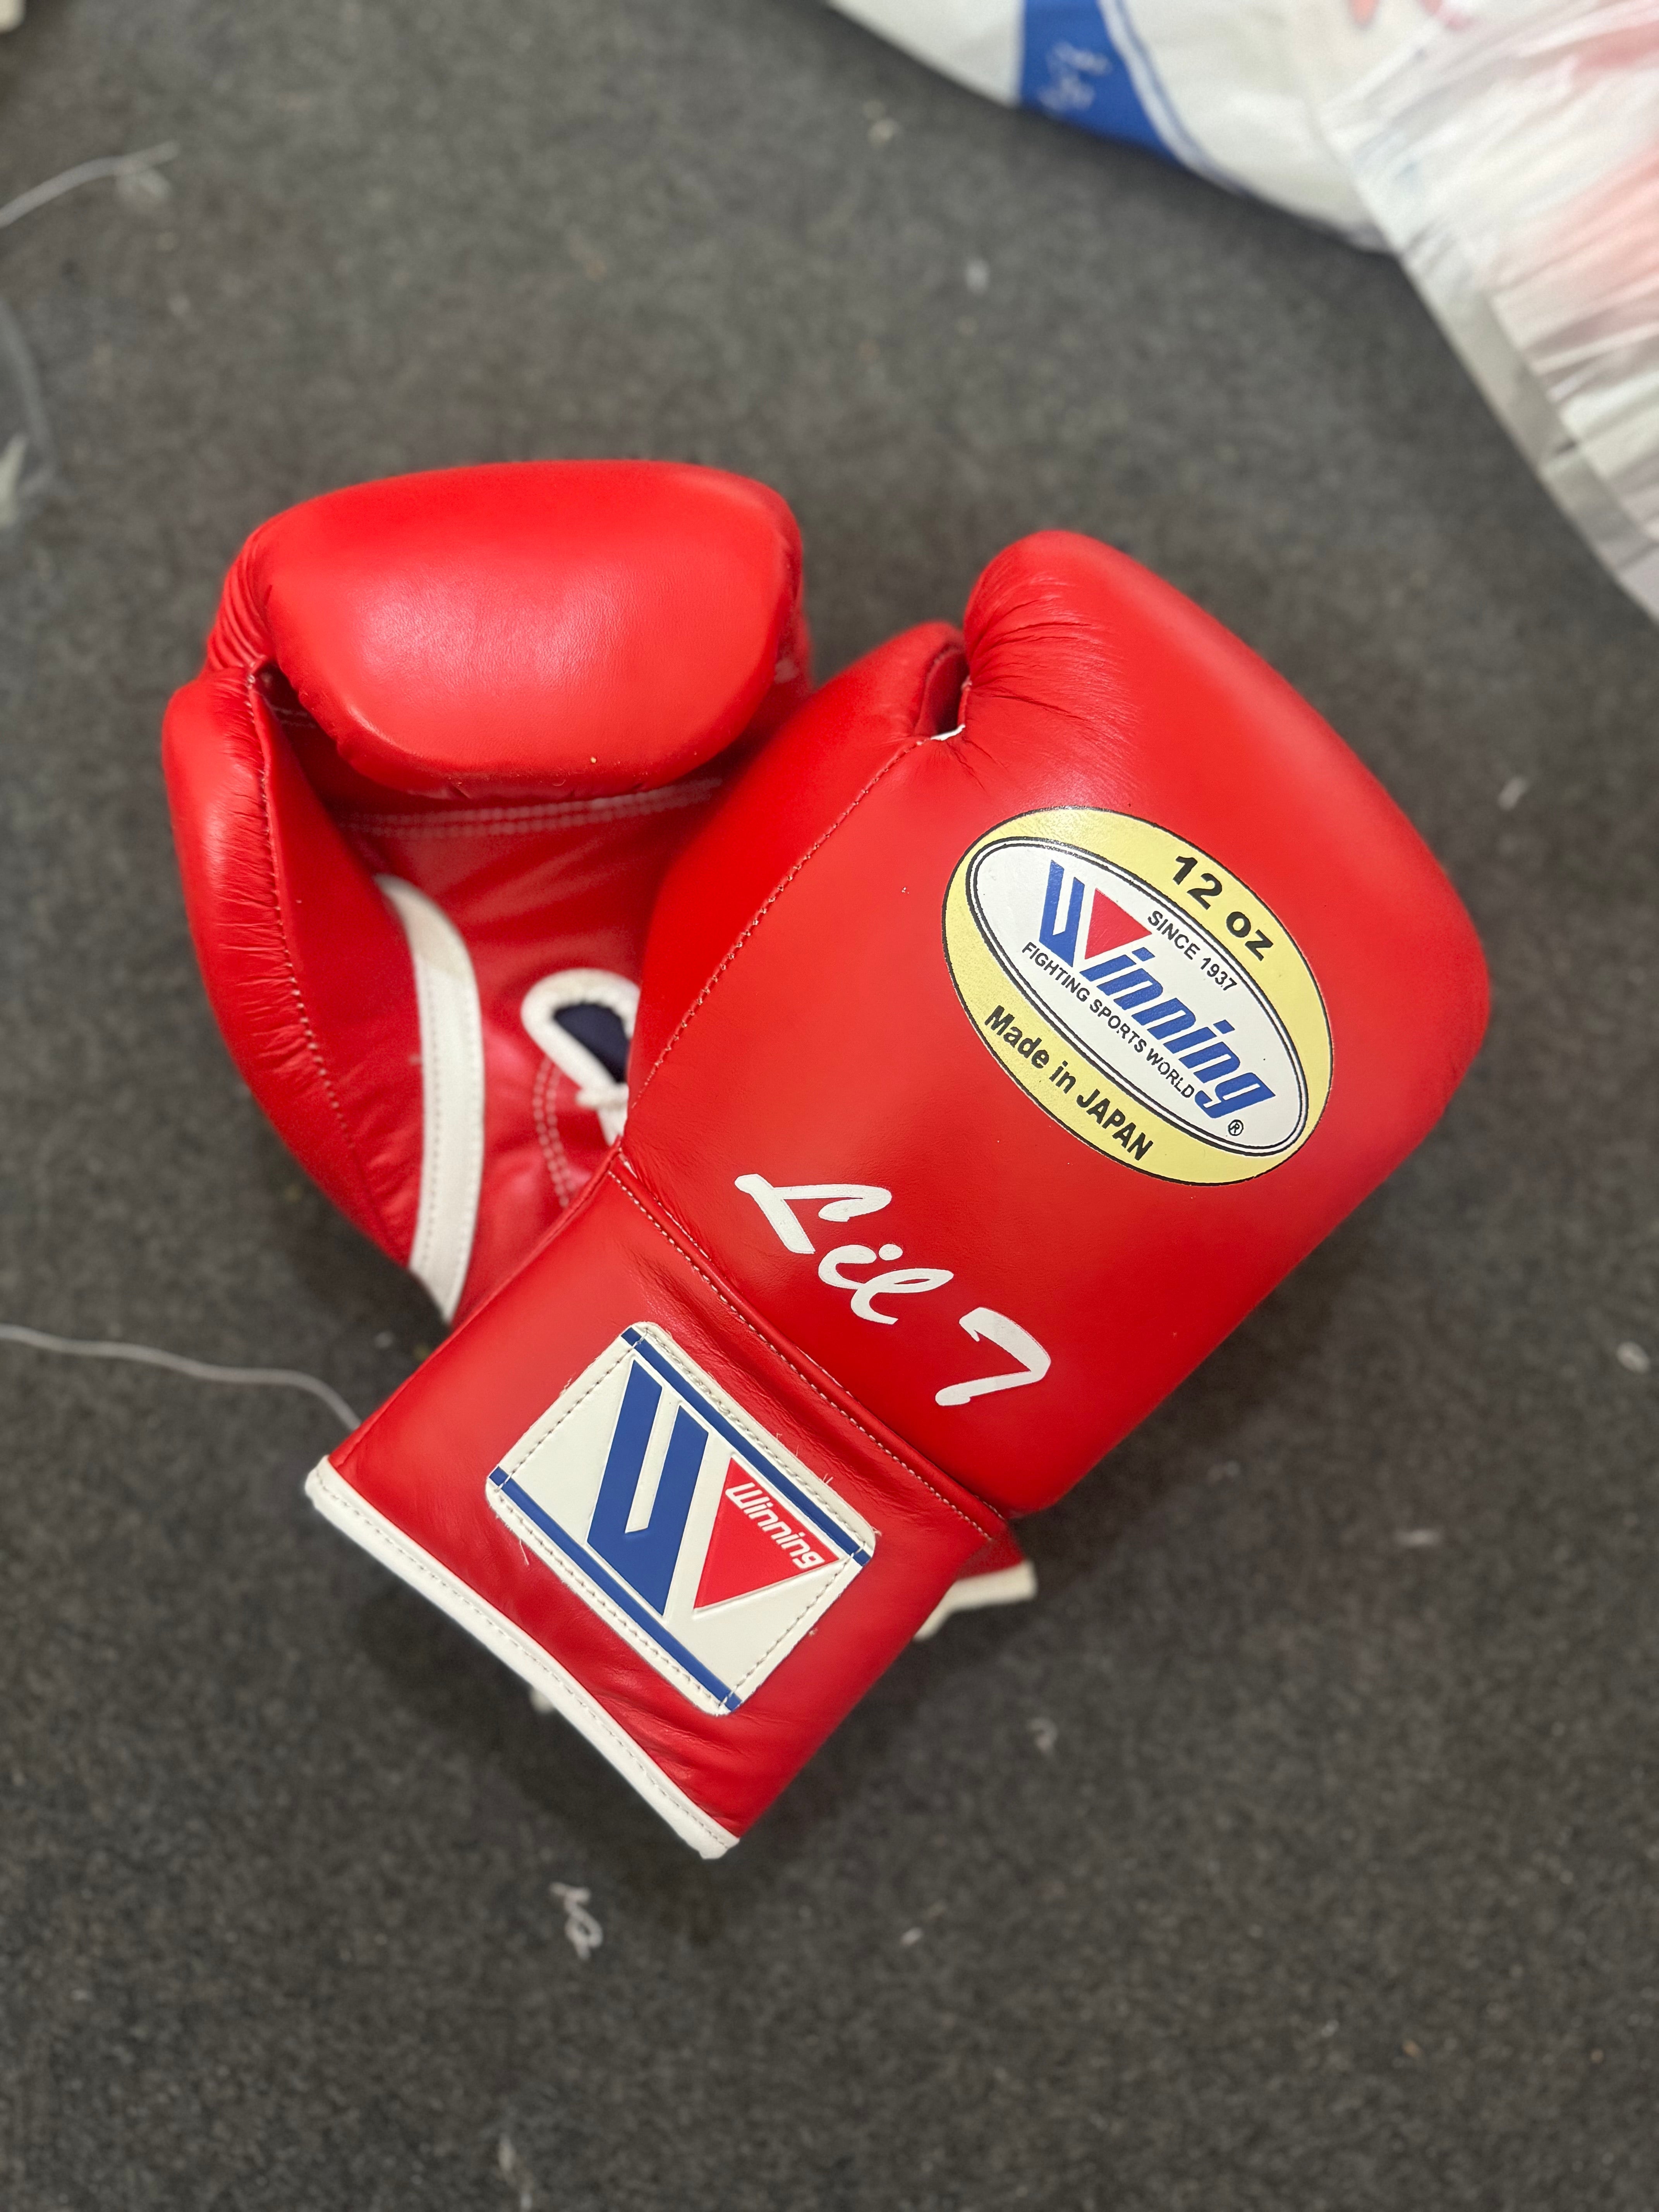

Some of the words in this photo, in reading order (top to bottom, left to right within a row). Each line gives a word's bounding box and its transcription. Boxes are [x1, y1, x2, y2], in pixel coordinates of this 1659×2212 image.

[1147, 910, 1201, 960] SINCE
[1200, 957, 1237, 991] 1937
[1172, 855, 1223, 911] 12
[1022, 941, 1091, 1002] FIGHTING
[1089, 999, 1147, 1053] SPORTS
[1146, 1048, 1195, 1099] WORLD
[1039, 860, 1276, 1118] Winning
[984, 1004, 1050, 1069] Made
[1048, 1060, 1077, 1094] in
[1076, 1087, 1154, 1161] JAPAN
[735, 1173, 954, 1325] Lil
[725, 1482, 825, 1569] Winning
